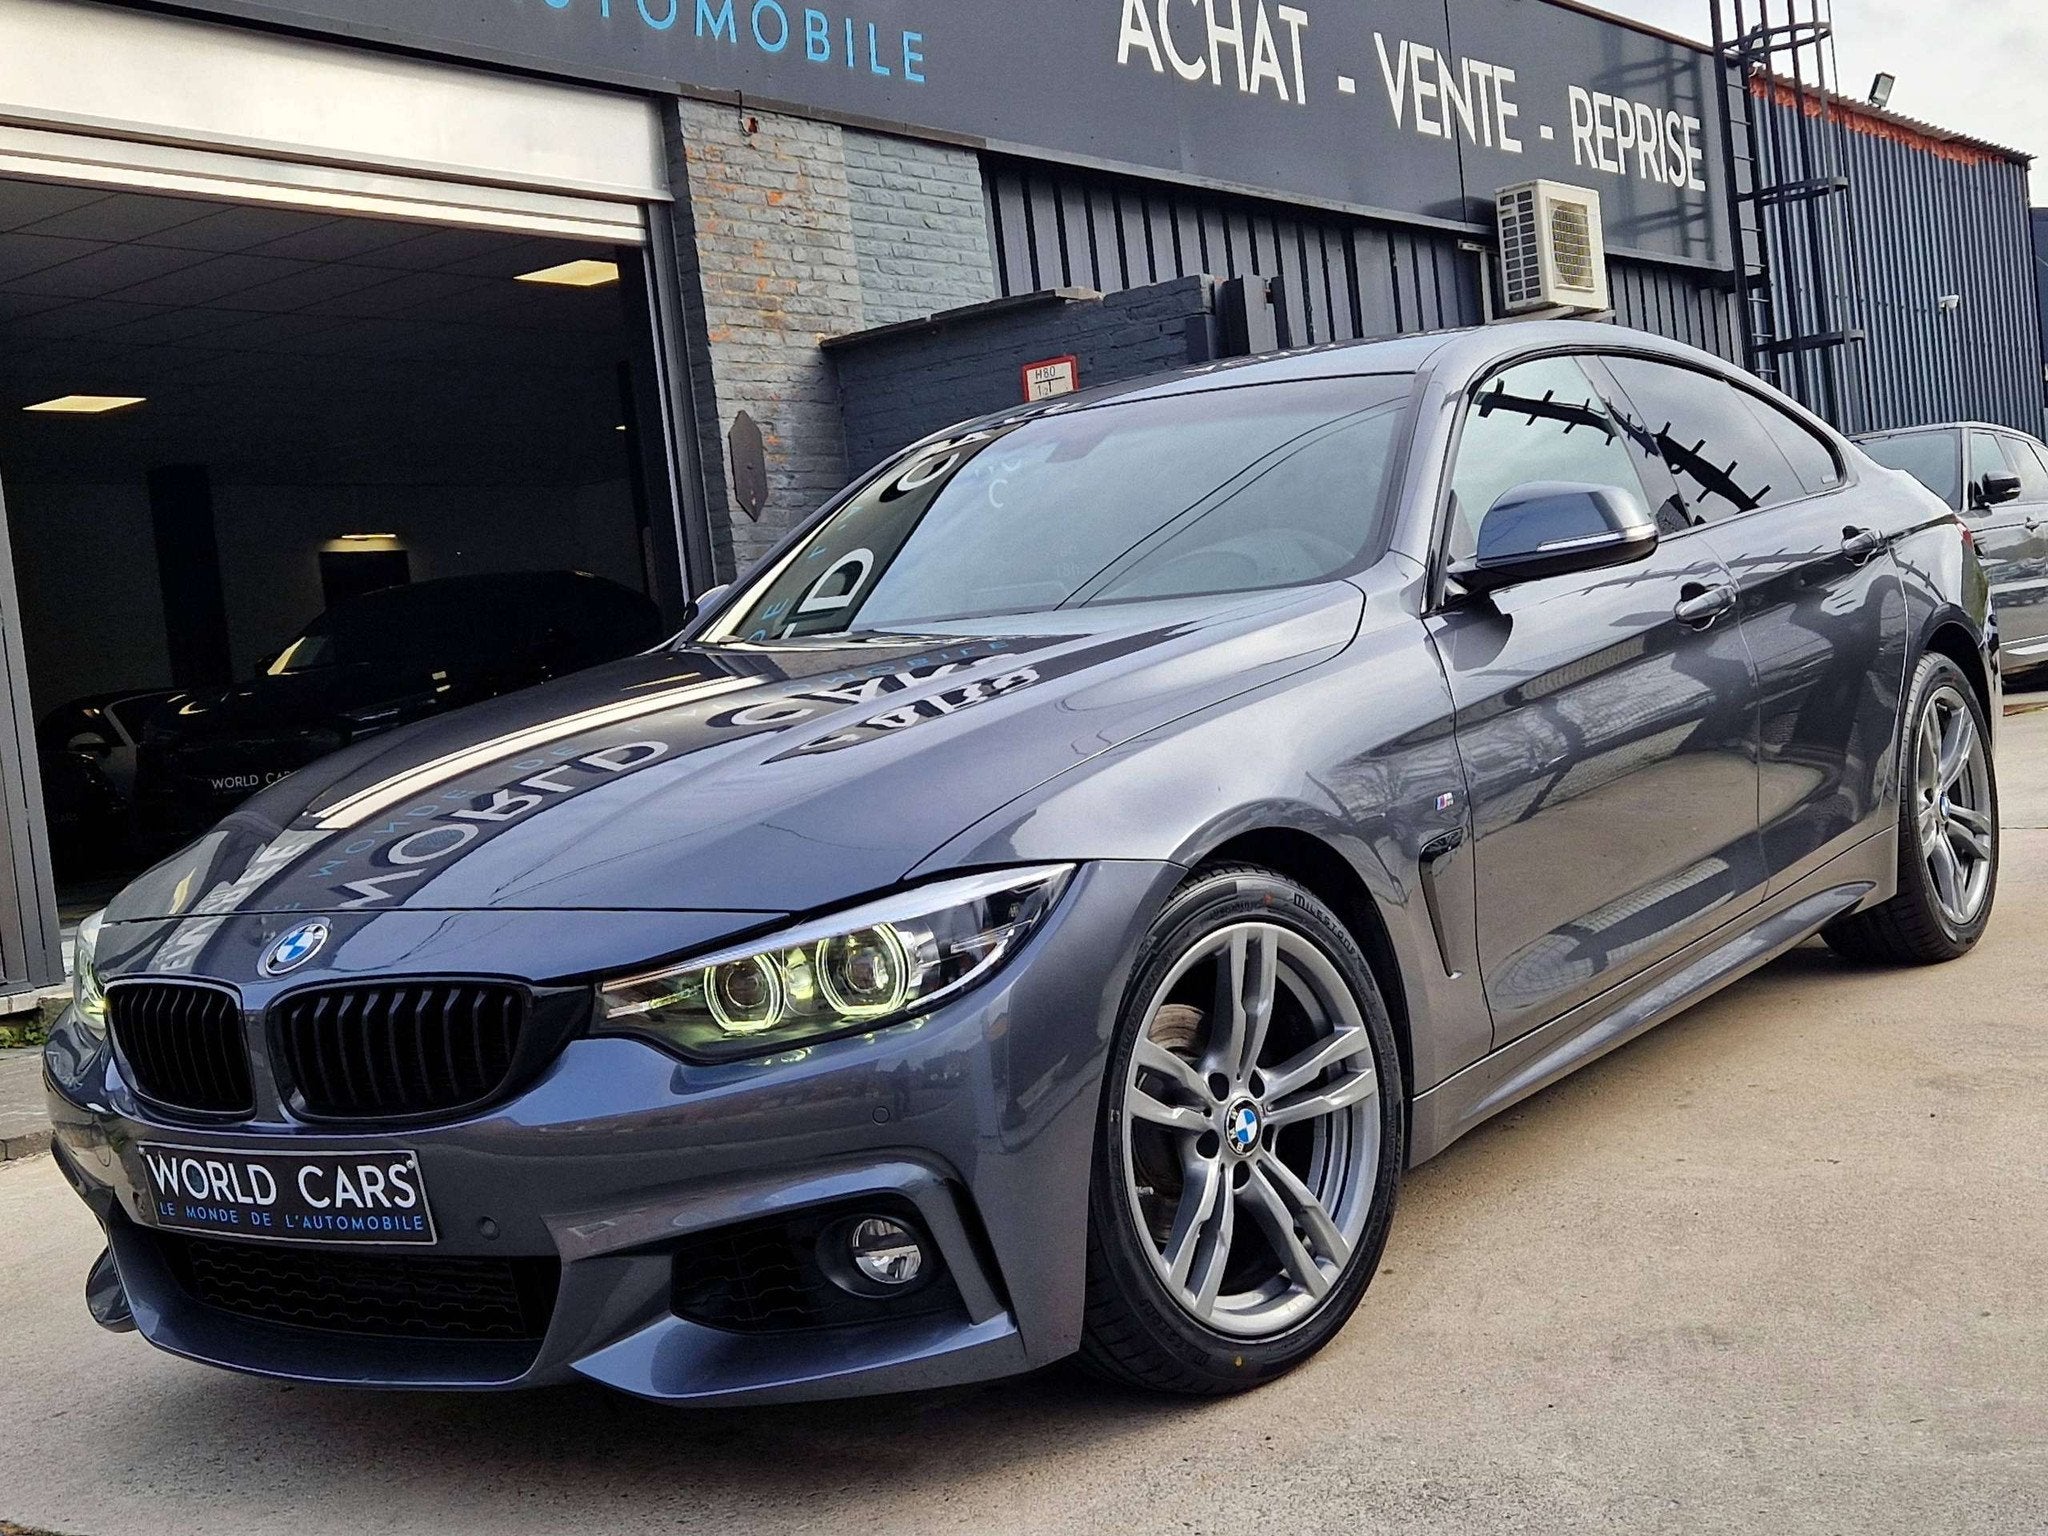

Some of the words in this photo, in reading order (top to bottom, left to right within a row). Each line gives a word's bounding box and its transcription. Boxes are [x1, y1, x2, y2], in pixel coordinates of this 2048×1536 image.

[1117, 0, 1308, 104] ACHAT
[1338, 75, 1356, 94] -
[1374, 32, 1522, 153] VENTE
[1540, 125, 1554, 140] -
[1568, 85, 1706, 192] REPRISE
[1035, 366, 1056, 379] H80
[211, 775, 259, 789] WORLD
[146, 1154, 277, 1206] WORLD
[298, 1163, 416, 1208] CARS
[159, 1202, 176, 1217] LE
[186, 1206, 239, 1224] MONDE
[251, 1212, 272, 1227] DE
[286, 1214, 424, 1231] L'AUTOMOBILE
